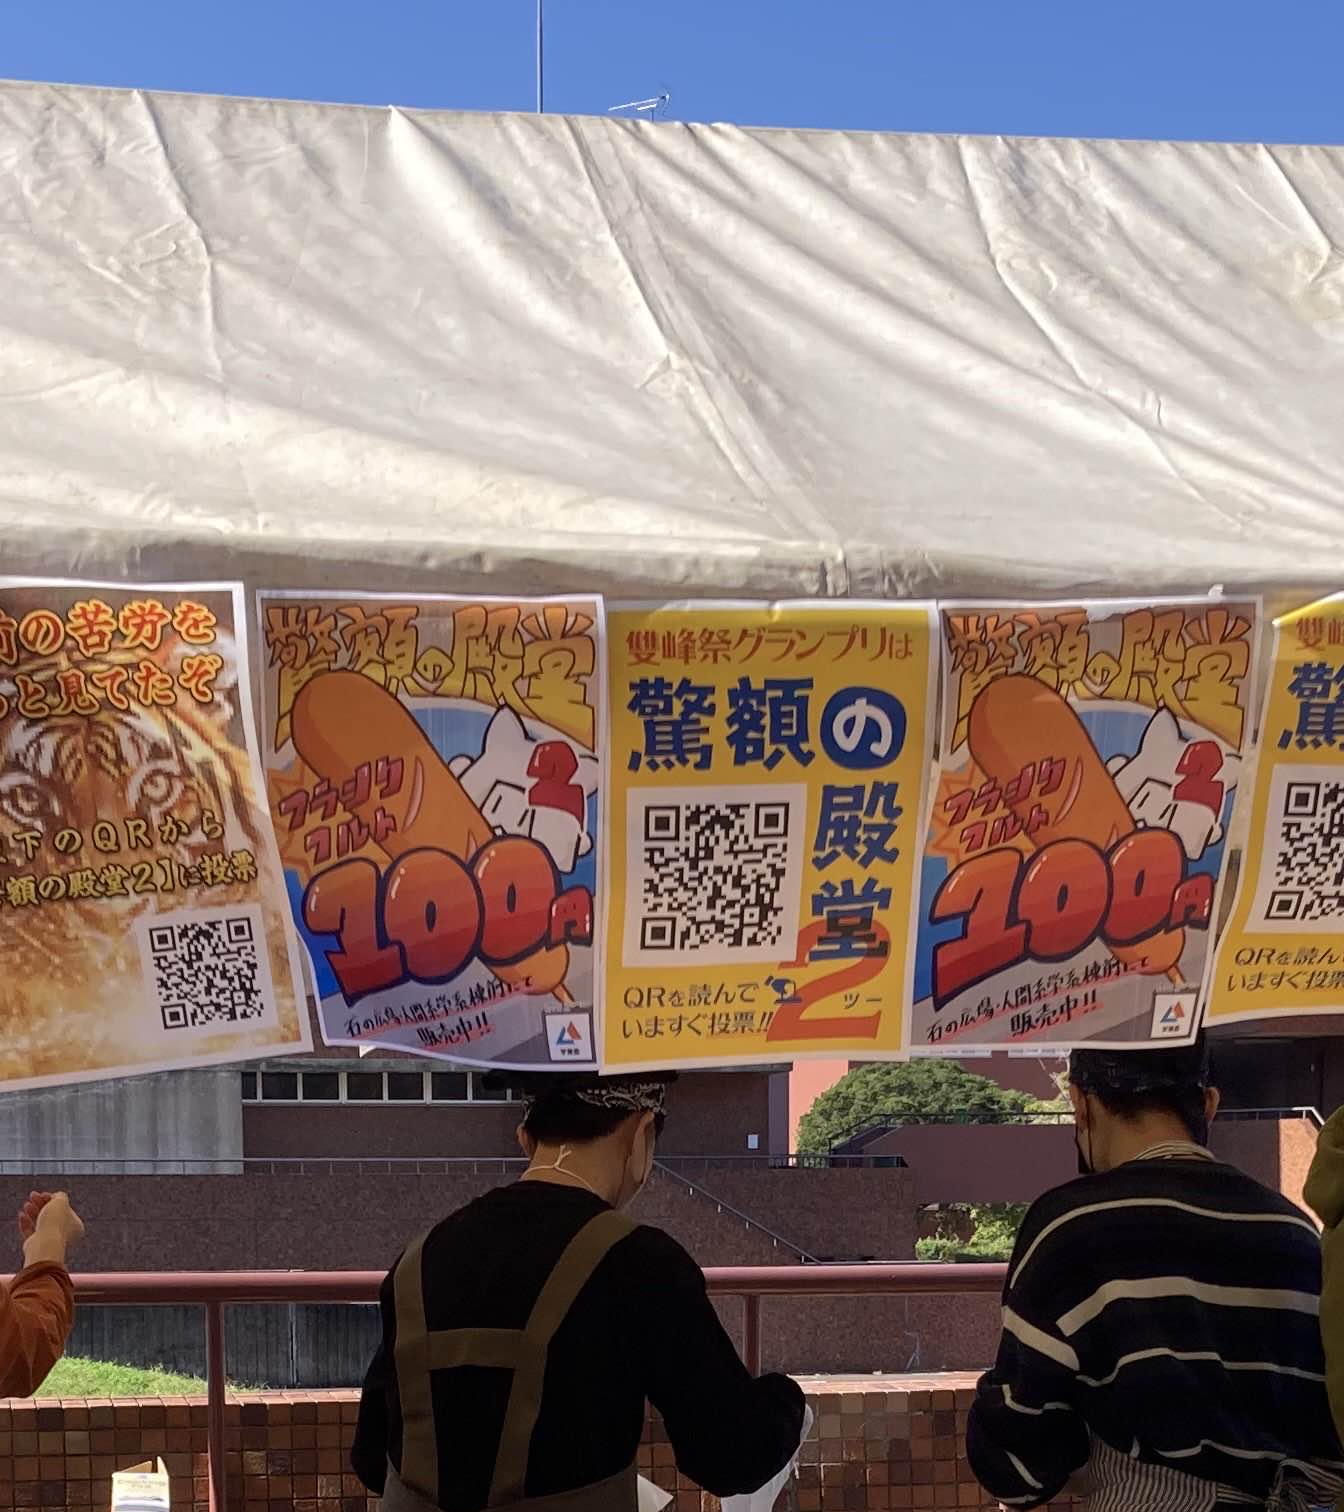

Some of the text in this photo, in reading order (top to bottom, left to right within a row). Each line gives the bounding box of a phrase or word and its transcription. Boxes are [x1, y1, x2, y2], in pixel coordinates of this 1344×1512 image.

[625, 624, 913, 667] 雙峰祭グランプリは
[304, 806, 398, 866] フルト
[960, 803, 1050, 852] フルト
[622, 981, 759, 1010] QRを読んで
